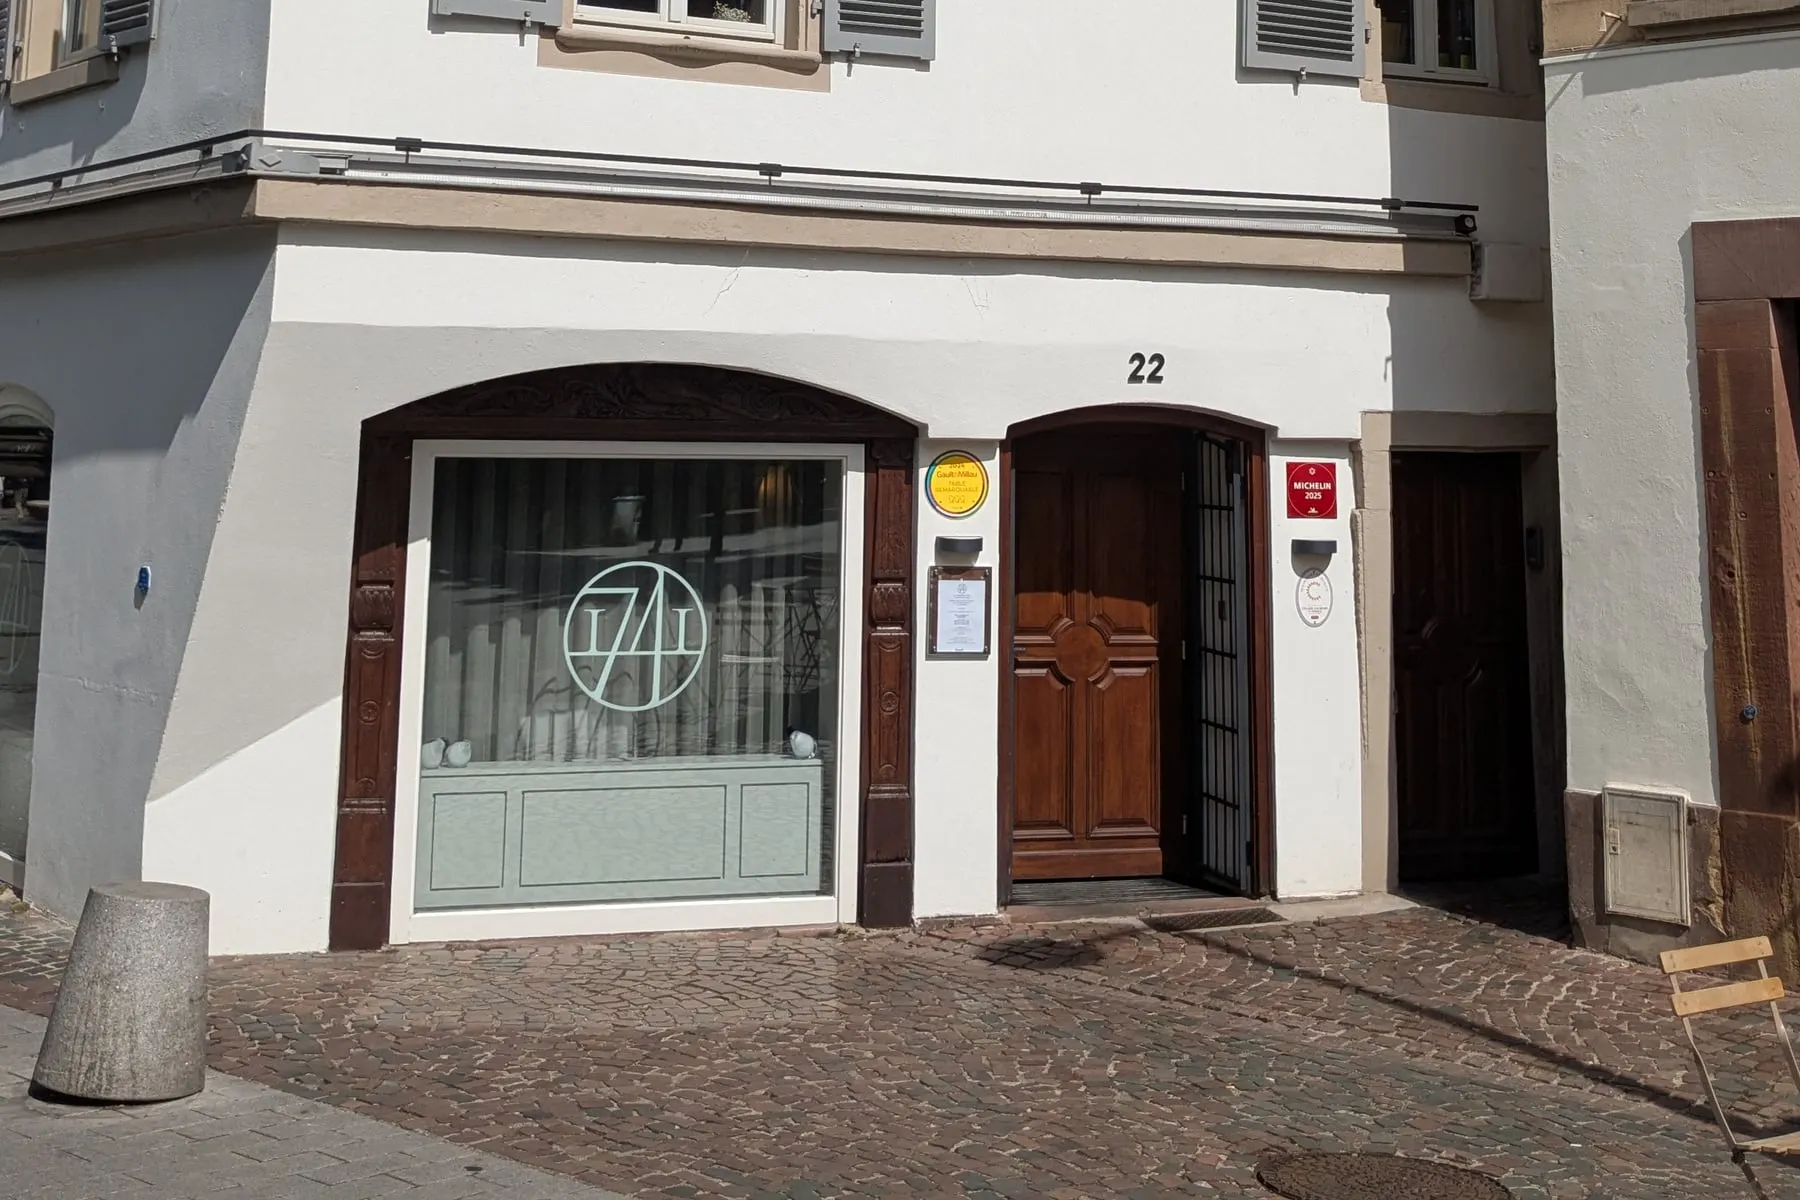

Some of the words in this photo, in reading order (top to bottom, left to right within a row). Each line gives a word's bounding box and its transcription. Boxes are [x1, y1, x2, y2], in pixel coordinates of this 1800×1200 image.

[1127, 352, 1165, 384] 22
[1293, 481, 1332, 490] MICHELIN
[1304, 491, 1322, 500] 2025
